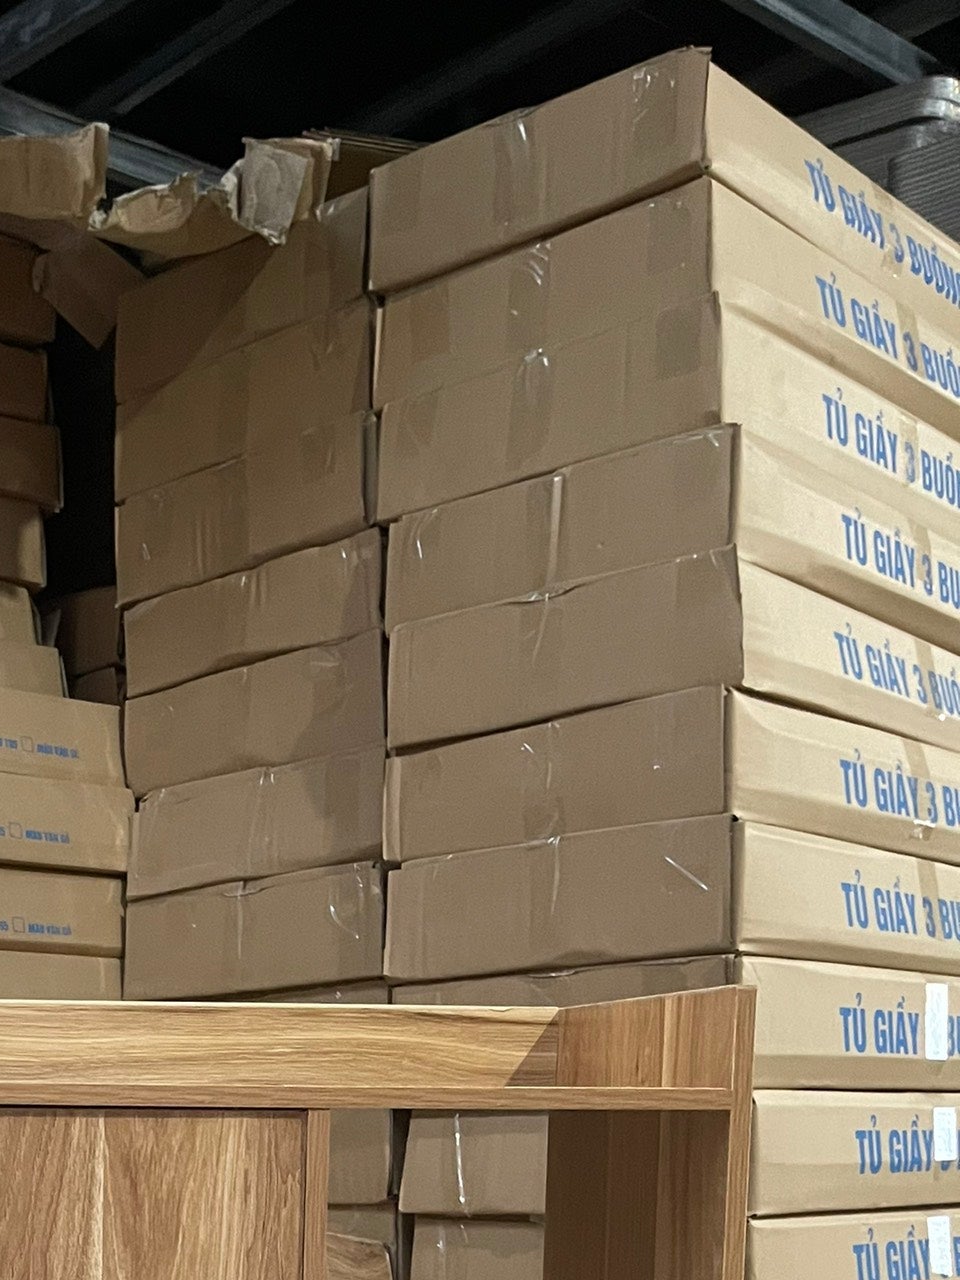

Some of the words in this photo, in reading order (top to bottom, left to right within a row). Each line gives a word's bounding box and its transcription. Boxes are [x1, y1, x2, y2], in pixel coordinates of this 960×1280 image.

[804, 158, 836, 212] TỦ
[815, 271, 846, 328] TỦ
[823, 387, 849, 447] TỦ
[841, 507, 868, 567] TỦ
[834, 622, 863, 681] TỦ
[840, 748, 868, 808] TỦ
[841, 869, 869, 930] TỦ
[840, 992, 868, 1055] TỦ
[855, 1115, 883, 1175] TỦ
